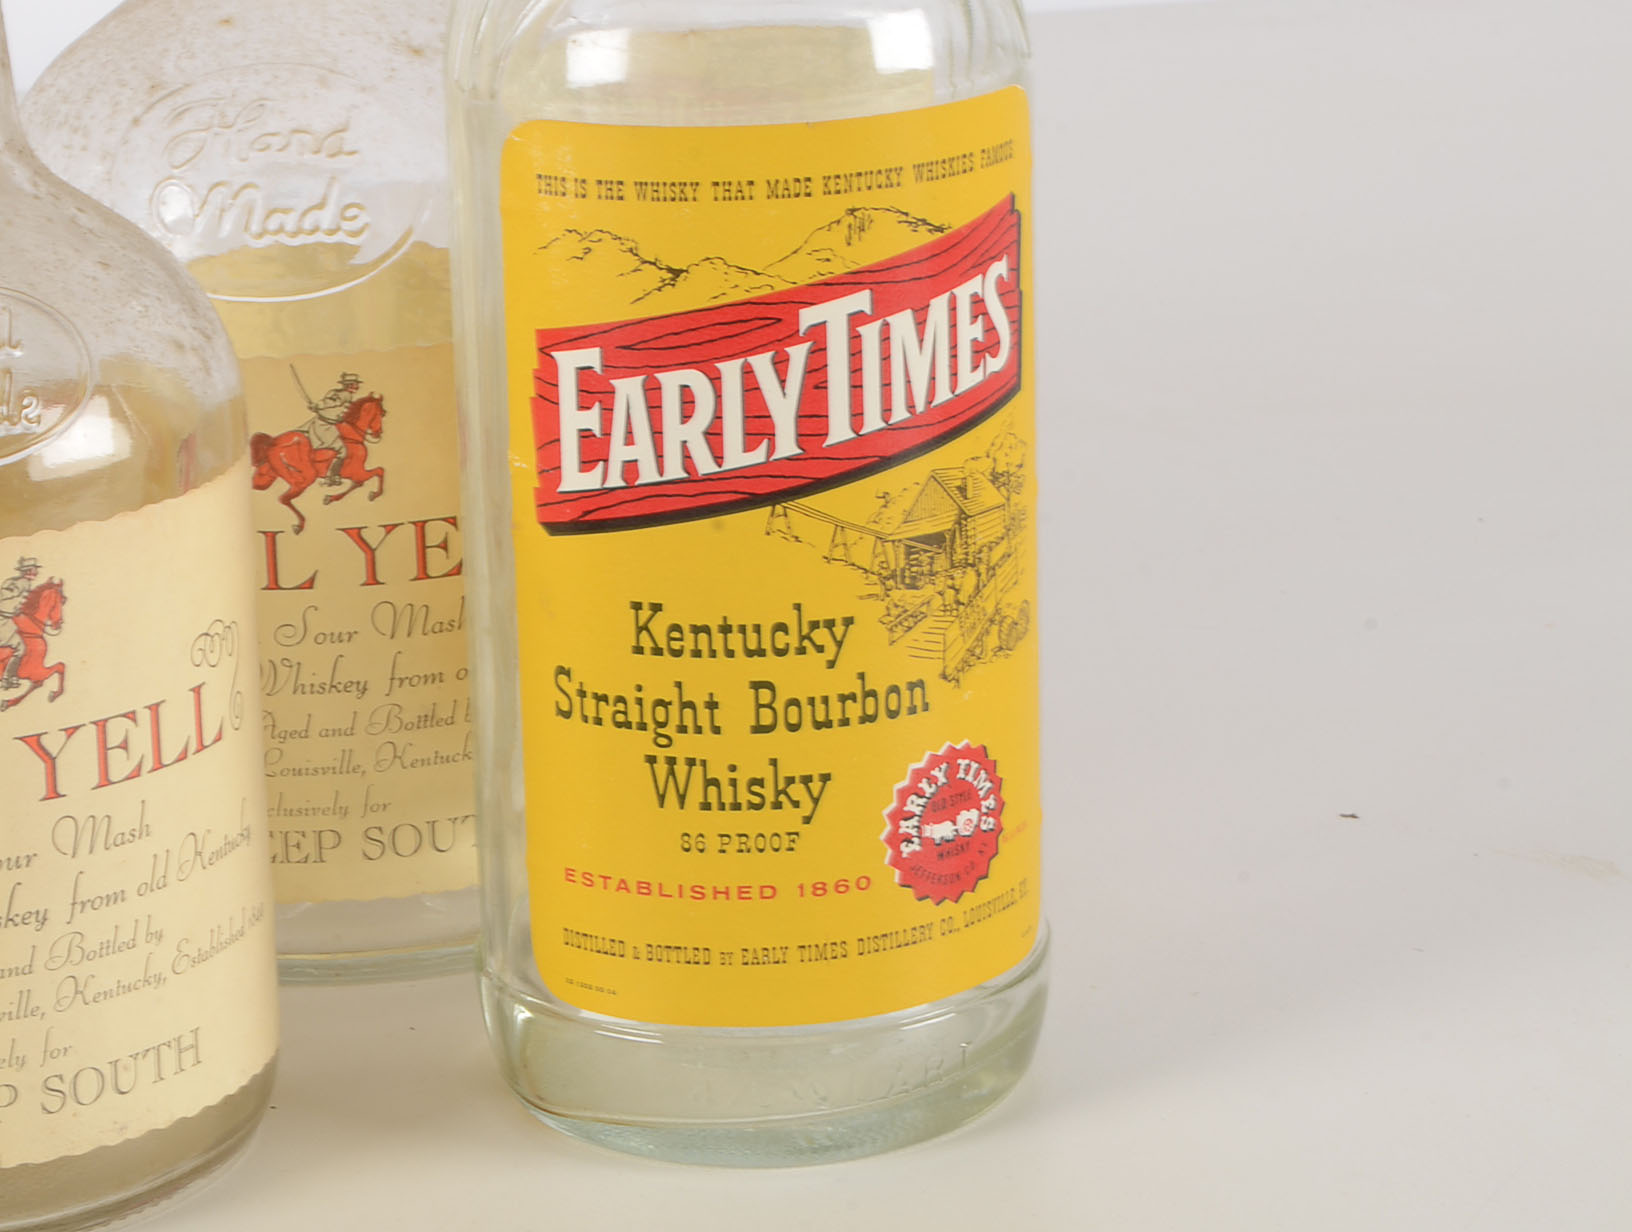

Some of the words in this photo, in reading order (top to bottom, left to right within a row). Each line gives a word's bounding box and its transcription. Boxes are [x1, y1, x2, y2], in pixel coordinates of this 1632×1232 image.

[536, 173, 567, 197] THIS
[574, 178, 587, 199] IS
[595, 179, 625, 201] THE
[633, 180, 699, 202] WHISKY
[711, 180, 755, 201] THAT
[766, 176, 813, 200] MADE
[822, 166, 904, 195] KENTUCKY
[912, 152, 975, 185] WHISKIES
[551, 341, 814, 493] EARLY
[799, 254, 1011, 448] TIMES
[273, 605, 359, 648] Sour
[630, 600, 855, 669] Kentucky
[259, 651, 369, 700] Whiskey
[384, 651, 445, 697] from
[261, 710, 312, 744] Aged
[318, 710, 358, 738] and
[365, 699, 457, 736] Bottled
[554, 664, 722, 749] Straight
[749, 670, 930, 735] Bourbon
[13, 681, 223, 801] YELL
[360, 783, 393, 819] for
[644, 753, 832, 825] Whisky
[899, 762, 950, 858] EARLY
[956, 758, 998, 832] TIMES
[52, 800, 150, 859] Mash
[680, 831, 707, 854] 86
[717, 830, 801, 854] PROOF
[66, 871, 126, 925] from
[137, 849, 170, 896] old
[564, 867, 777, 901] ESTABLISHED
[798, 875, 871, 898] 1860
[45, 919, 138, 971] Bottled
[145, 914, 163, 946] by
[563, 927, 625, 958] DISTILLED
[646, 943, 710, 966] BOTTLED
[740, 946, 789, 966] EARLY
[797, 940, 848, 963] TIMES
[857, 921, 934, 957] DISTILLERY
[40, 1026, 73, 1067] for
[40, 1026, 202, 1114] SOUTH
